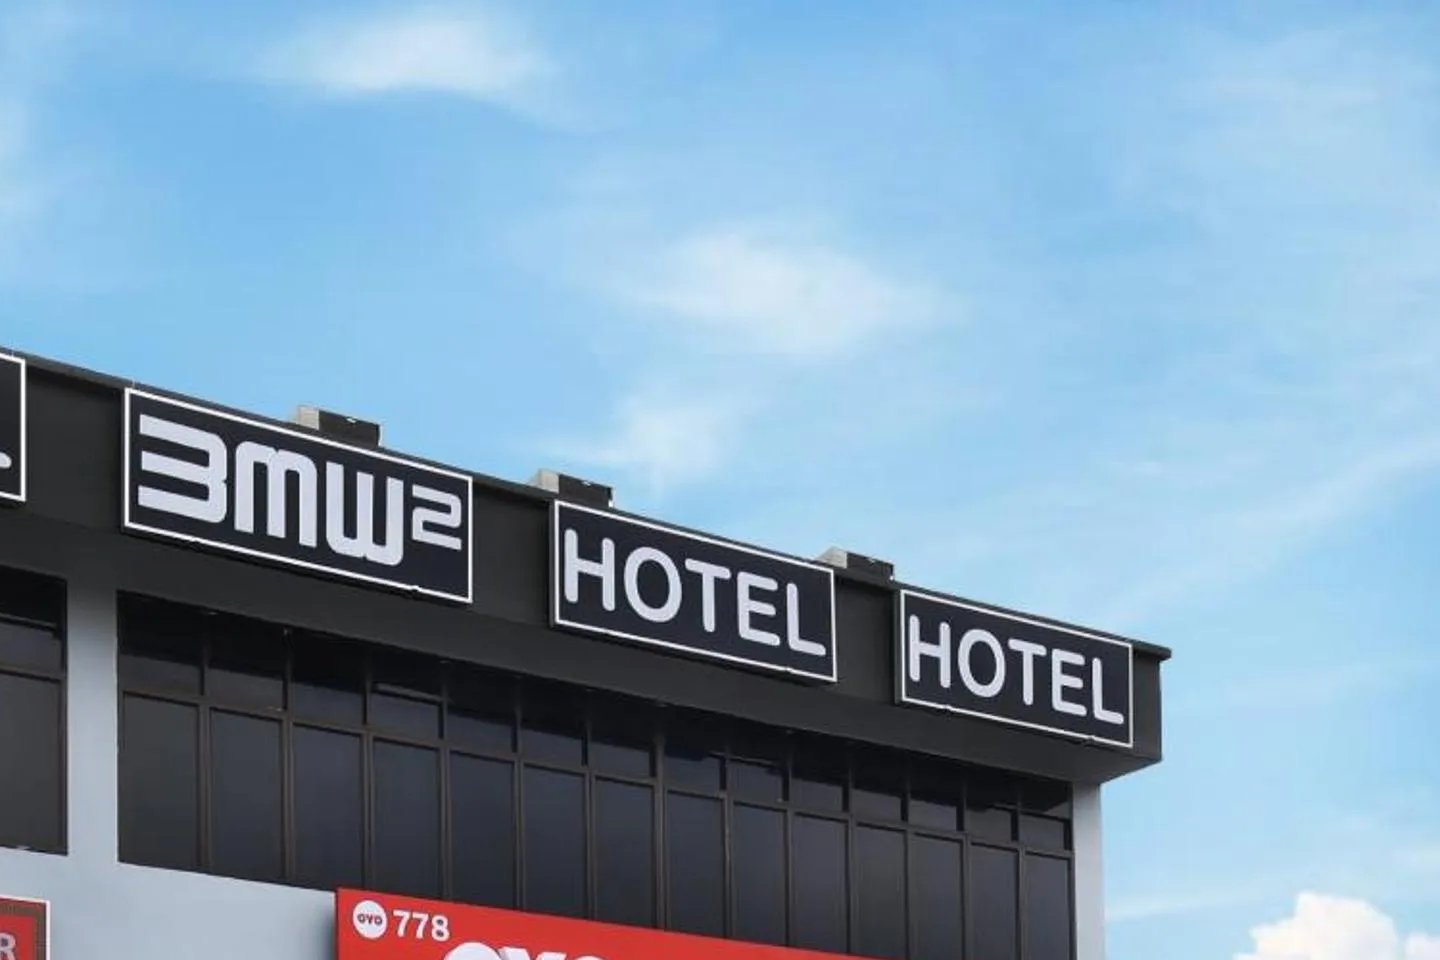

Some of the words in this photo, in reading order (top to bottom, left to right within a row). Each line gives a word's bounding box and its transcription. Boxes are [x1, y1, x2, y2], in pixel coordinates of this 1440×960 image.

[564, 529, 826, 656] HOTEL
[909, 615, 1123, 724] HOTEL
[356, 912, 383, 926] OYO
[393, 909, 450, 941] 778
